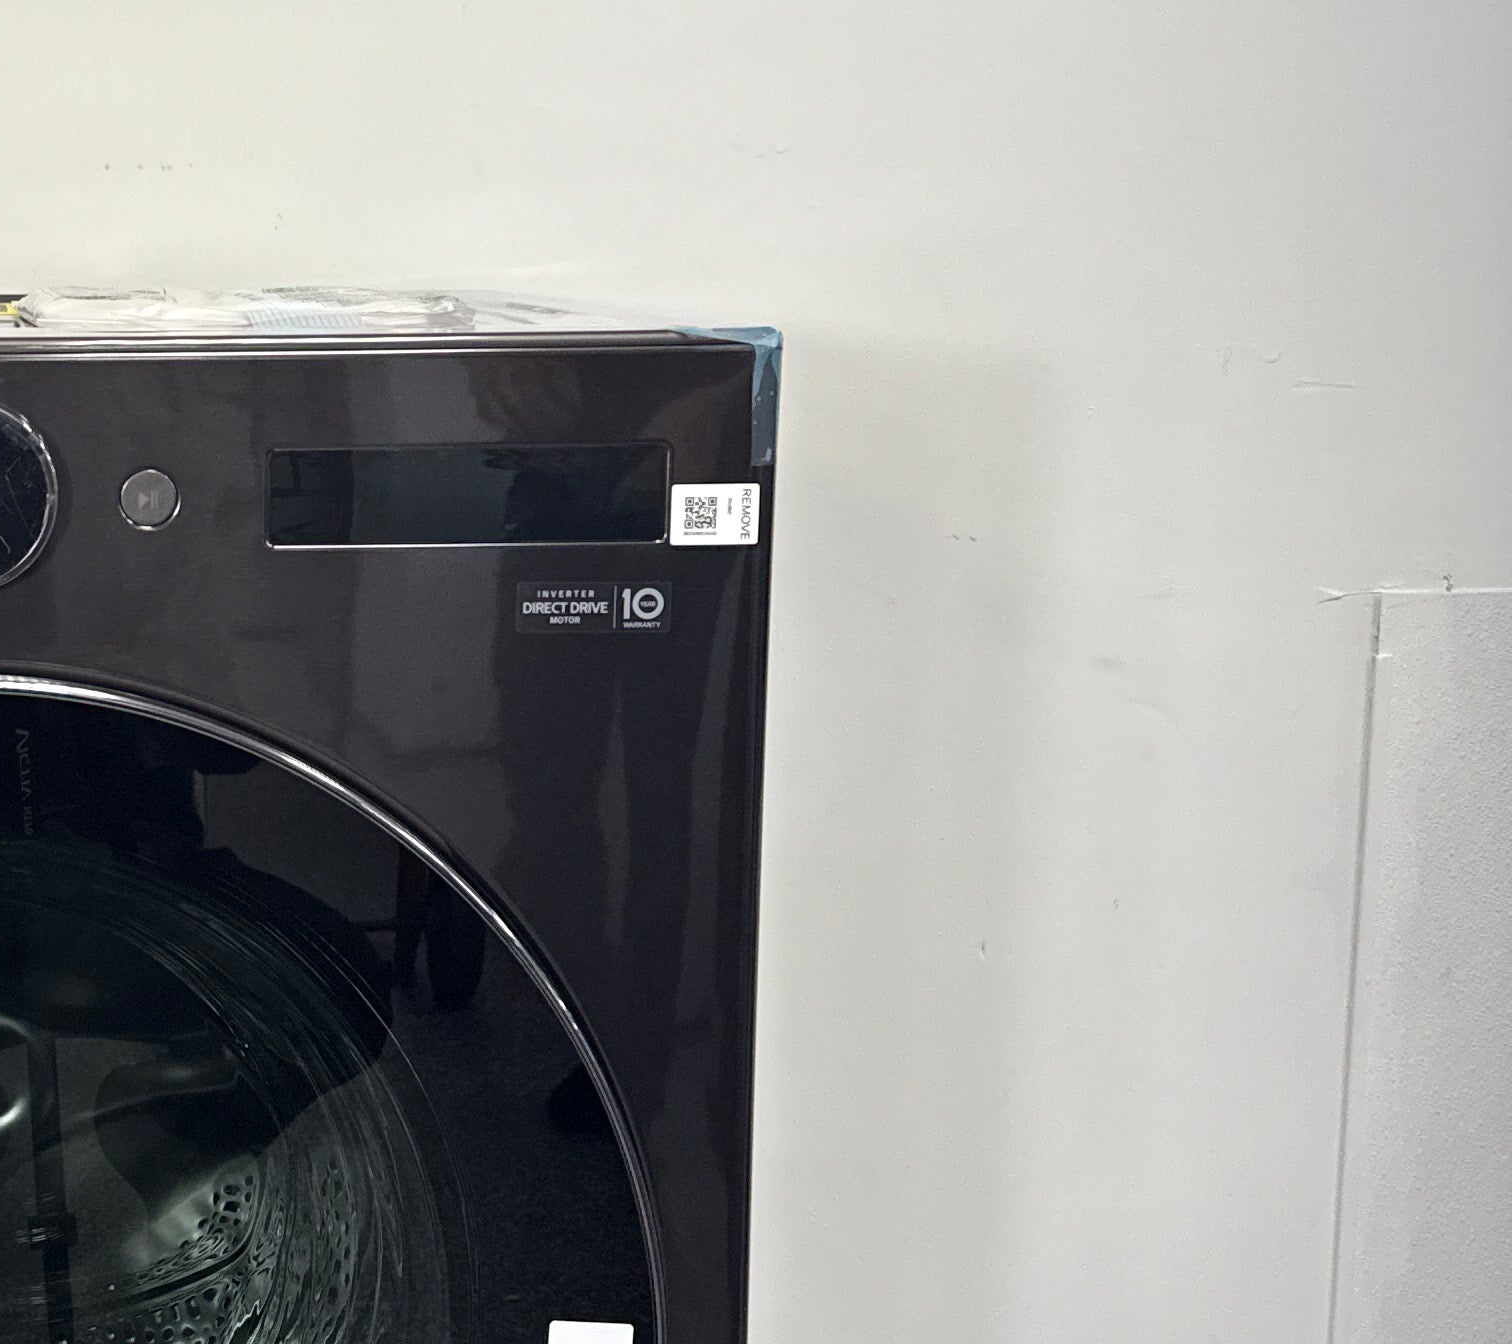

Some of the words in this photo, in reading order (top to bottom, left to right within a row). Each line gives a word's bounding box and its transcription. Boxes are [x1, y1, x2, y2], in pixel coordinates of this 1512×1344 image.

[740, 488, 752, 540] REMOVE
[537, 589, 595, 598] INVERTER
[522, 601, 569, 614] DIRECT
[570, 601, 609, 614] DRIVE
[622, 587, 665, 620] 10
[549, 616, 581, 624] MOTOR
